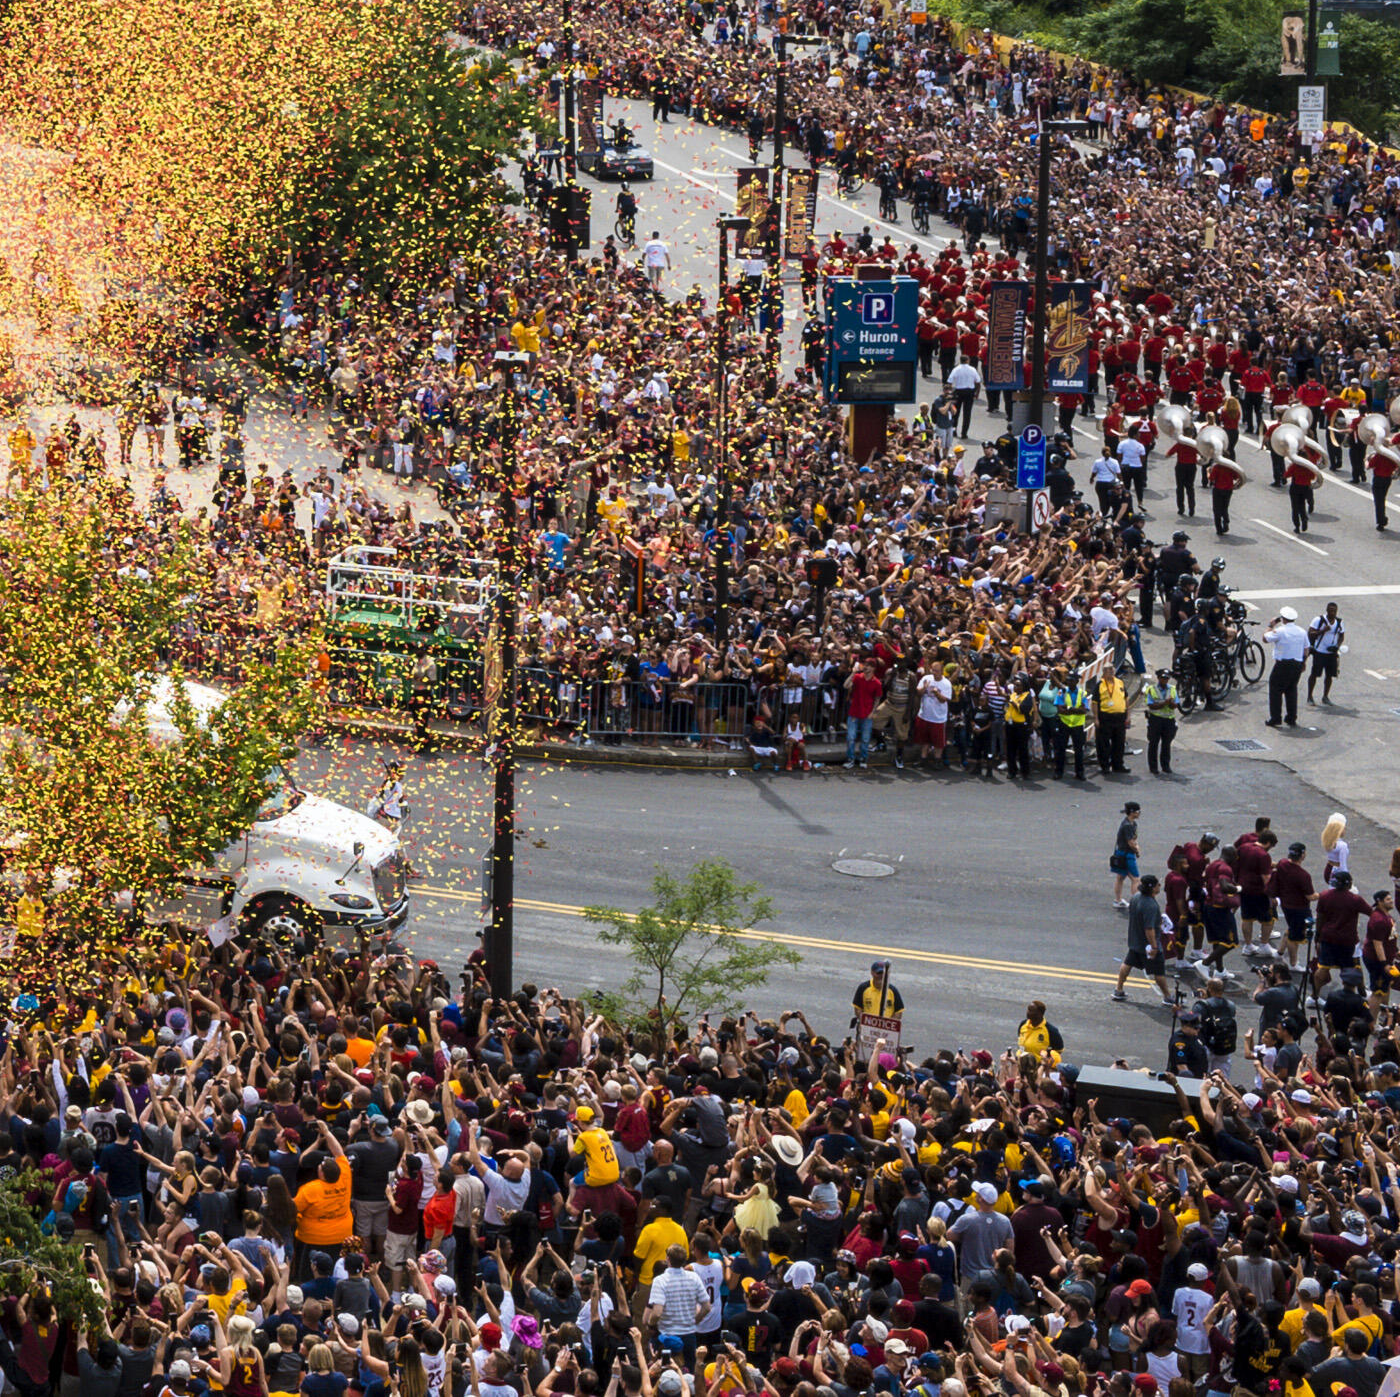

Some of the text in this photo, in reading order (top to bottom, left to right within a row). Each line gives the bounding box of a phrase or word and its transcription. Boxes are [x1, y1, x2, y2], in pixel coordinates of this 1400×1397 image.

[871, 298, 885, 319] P
[859, 330, 898, 343] Huron
[991, 288, 1017, 384] CAVALIERS
[1012, 309, 1025, 362] CLEVELAND
[859, 346, 895, 355] Entrance
[1027, 428, 1039, 442] P
[864, 1016, 897, 1030] NOTICE
[600, 1146, 612, 1163] 23
[1186, 1308, 1196, 1327] 2
[243, 1365, 252, 1384] 2
[428, 1372, 444, 1388] 23
